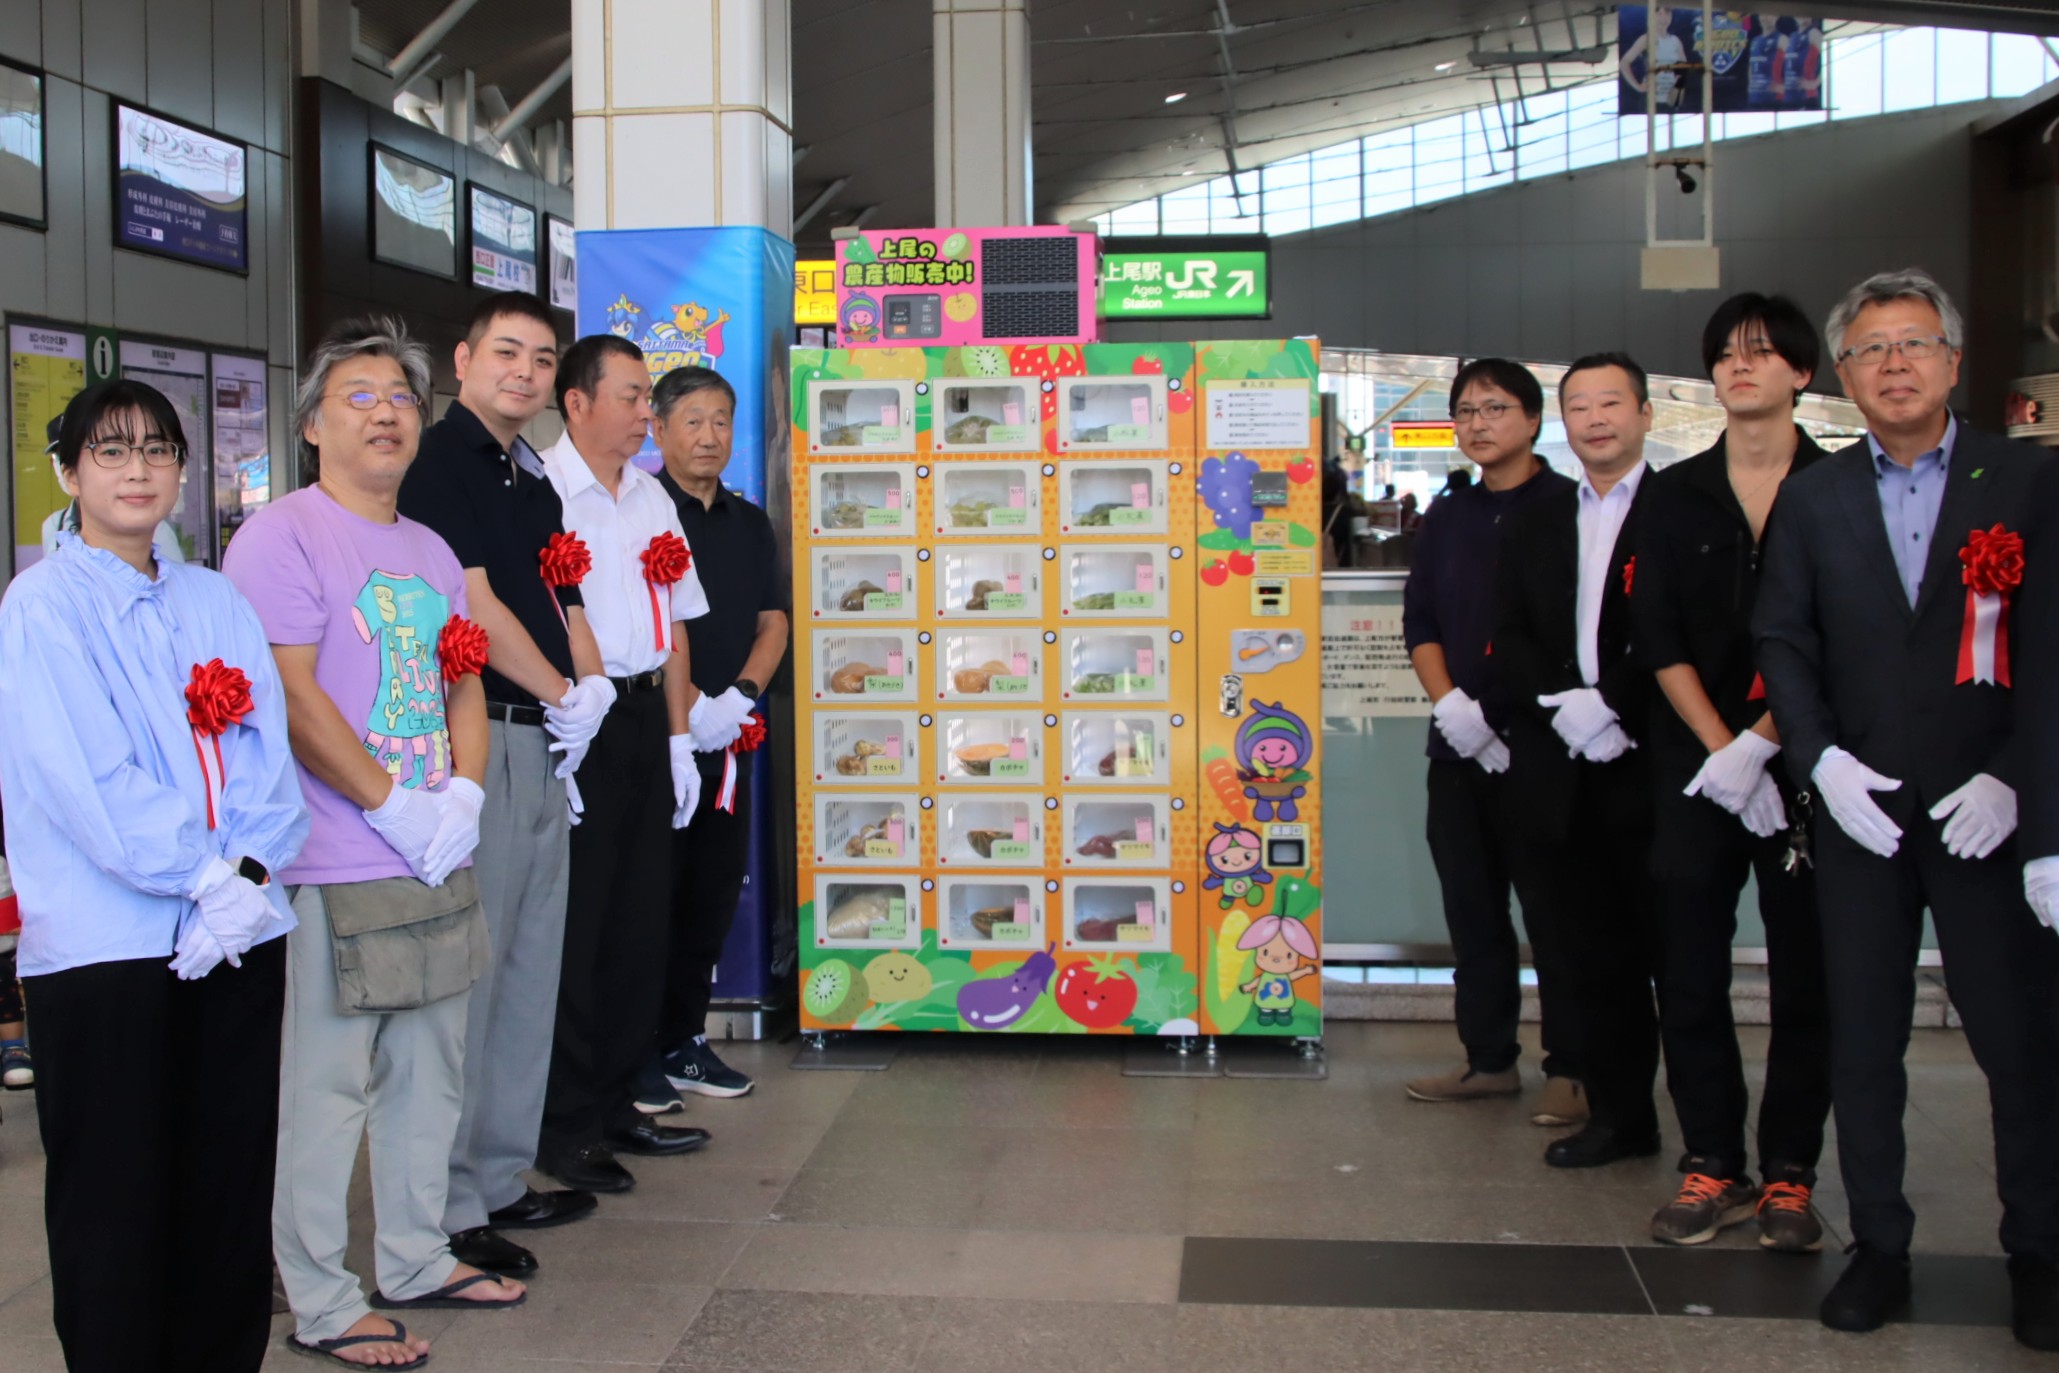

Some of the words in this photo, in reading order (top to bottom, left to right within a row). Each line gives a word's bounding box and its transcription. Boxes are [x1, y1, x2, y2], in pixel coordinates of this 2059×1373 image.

[879, 238, 936, 259] 上尾の
[1104, 261, 1162, 281] 上尾駅
[1165, 260, 1217, 289] JR
[1132, 285, 1163, 297] Ageo
[809, 301, 837, 315] Eas
[1122, 297, 1163, 309] Station
[637, 340, 690, 350] SAITAMA
[872, 764, 897, 773] さといも
[999, 764, 1024, 772] カボチャ
[870, 847, 895, 855] さといも
[999, 846, 1024, 854] カボチャ
